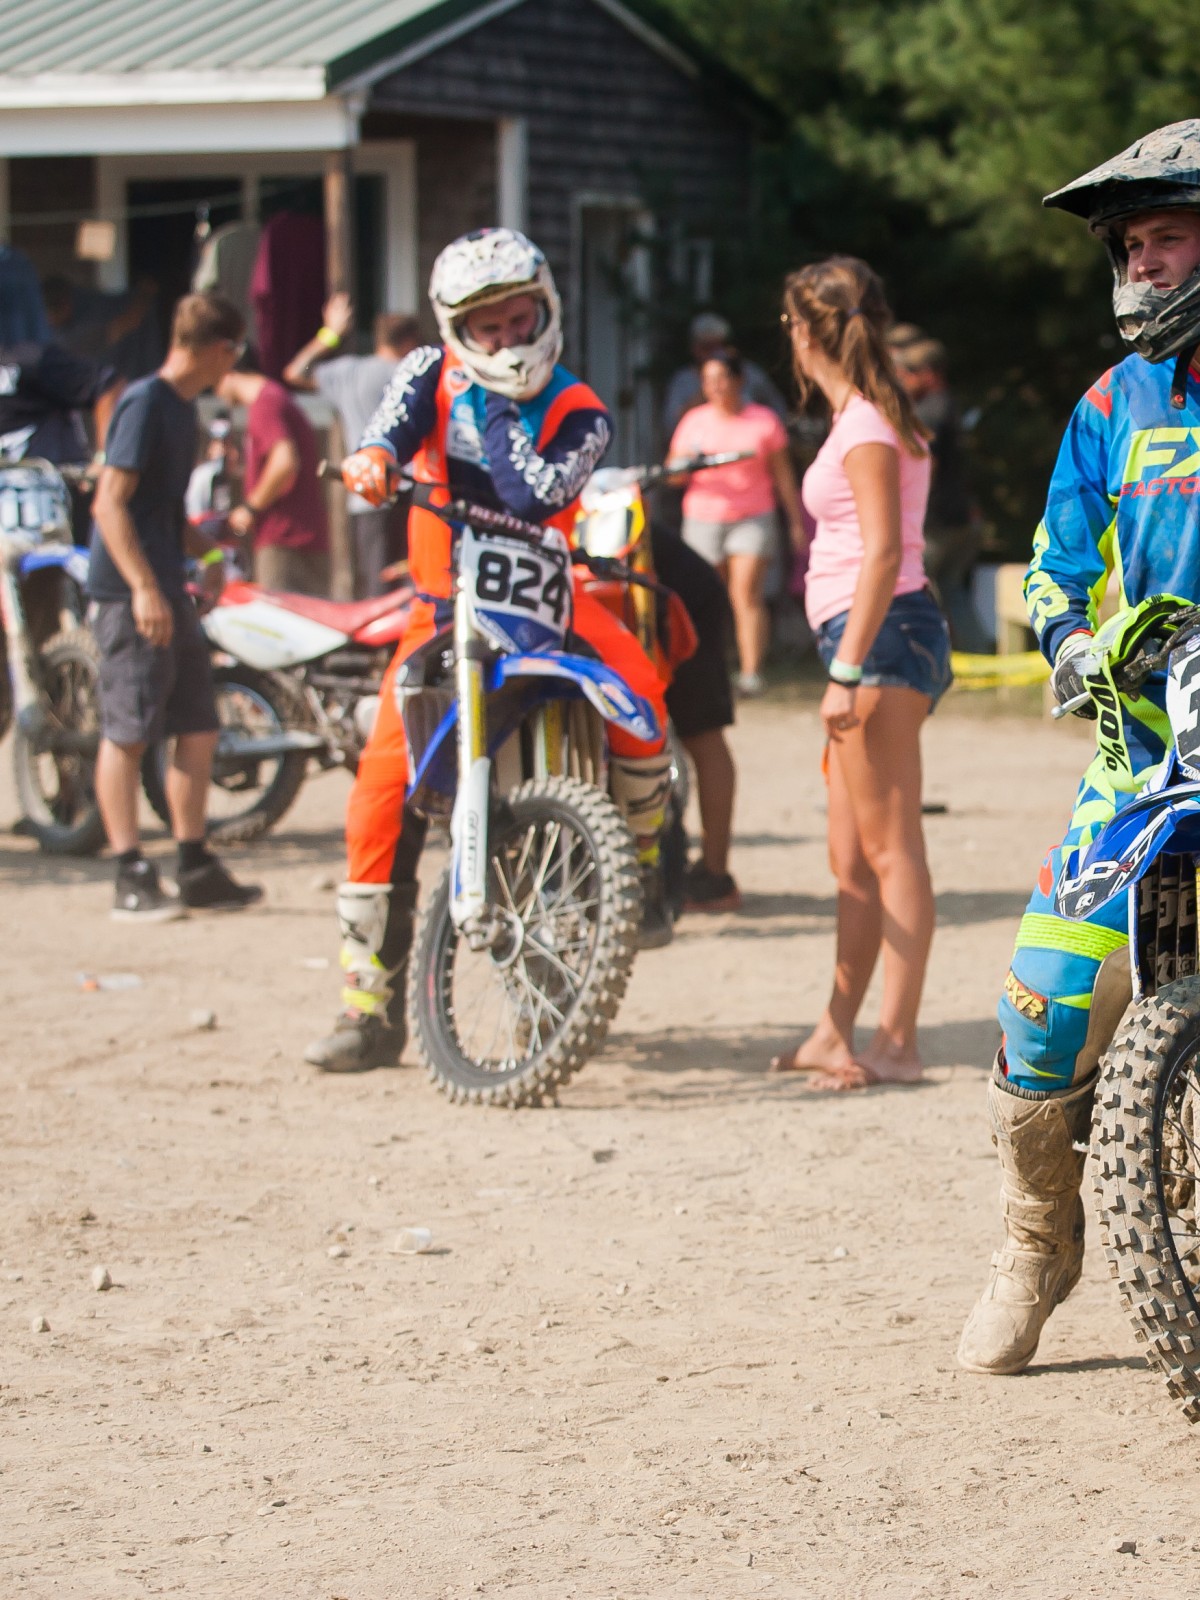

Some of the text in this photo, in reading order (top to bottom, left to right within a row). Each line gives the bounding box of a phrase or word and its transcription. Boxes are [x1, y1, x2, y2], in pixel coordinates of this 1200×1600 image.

[475, 550, 566, 625] 824
[1085, 667, 1129, 772] 100%
[1004, 970, 1045, 1019] FXR
